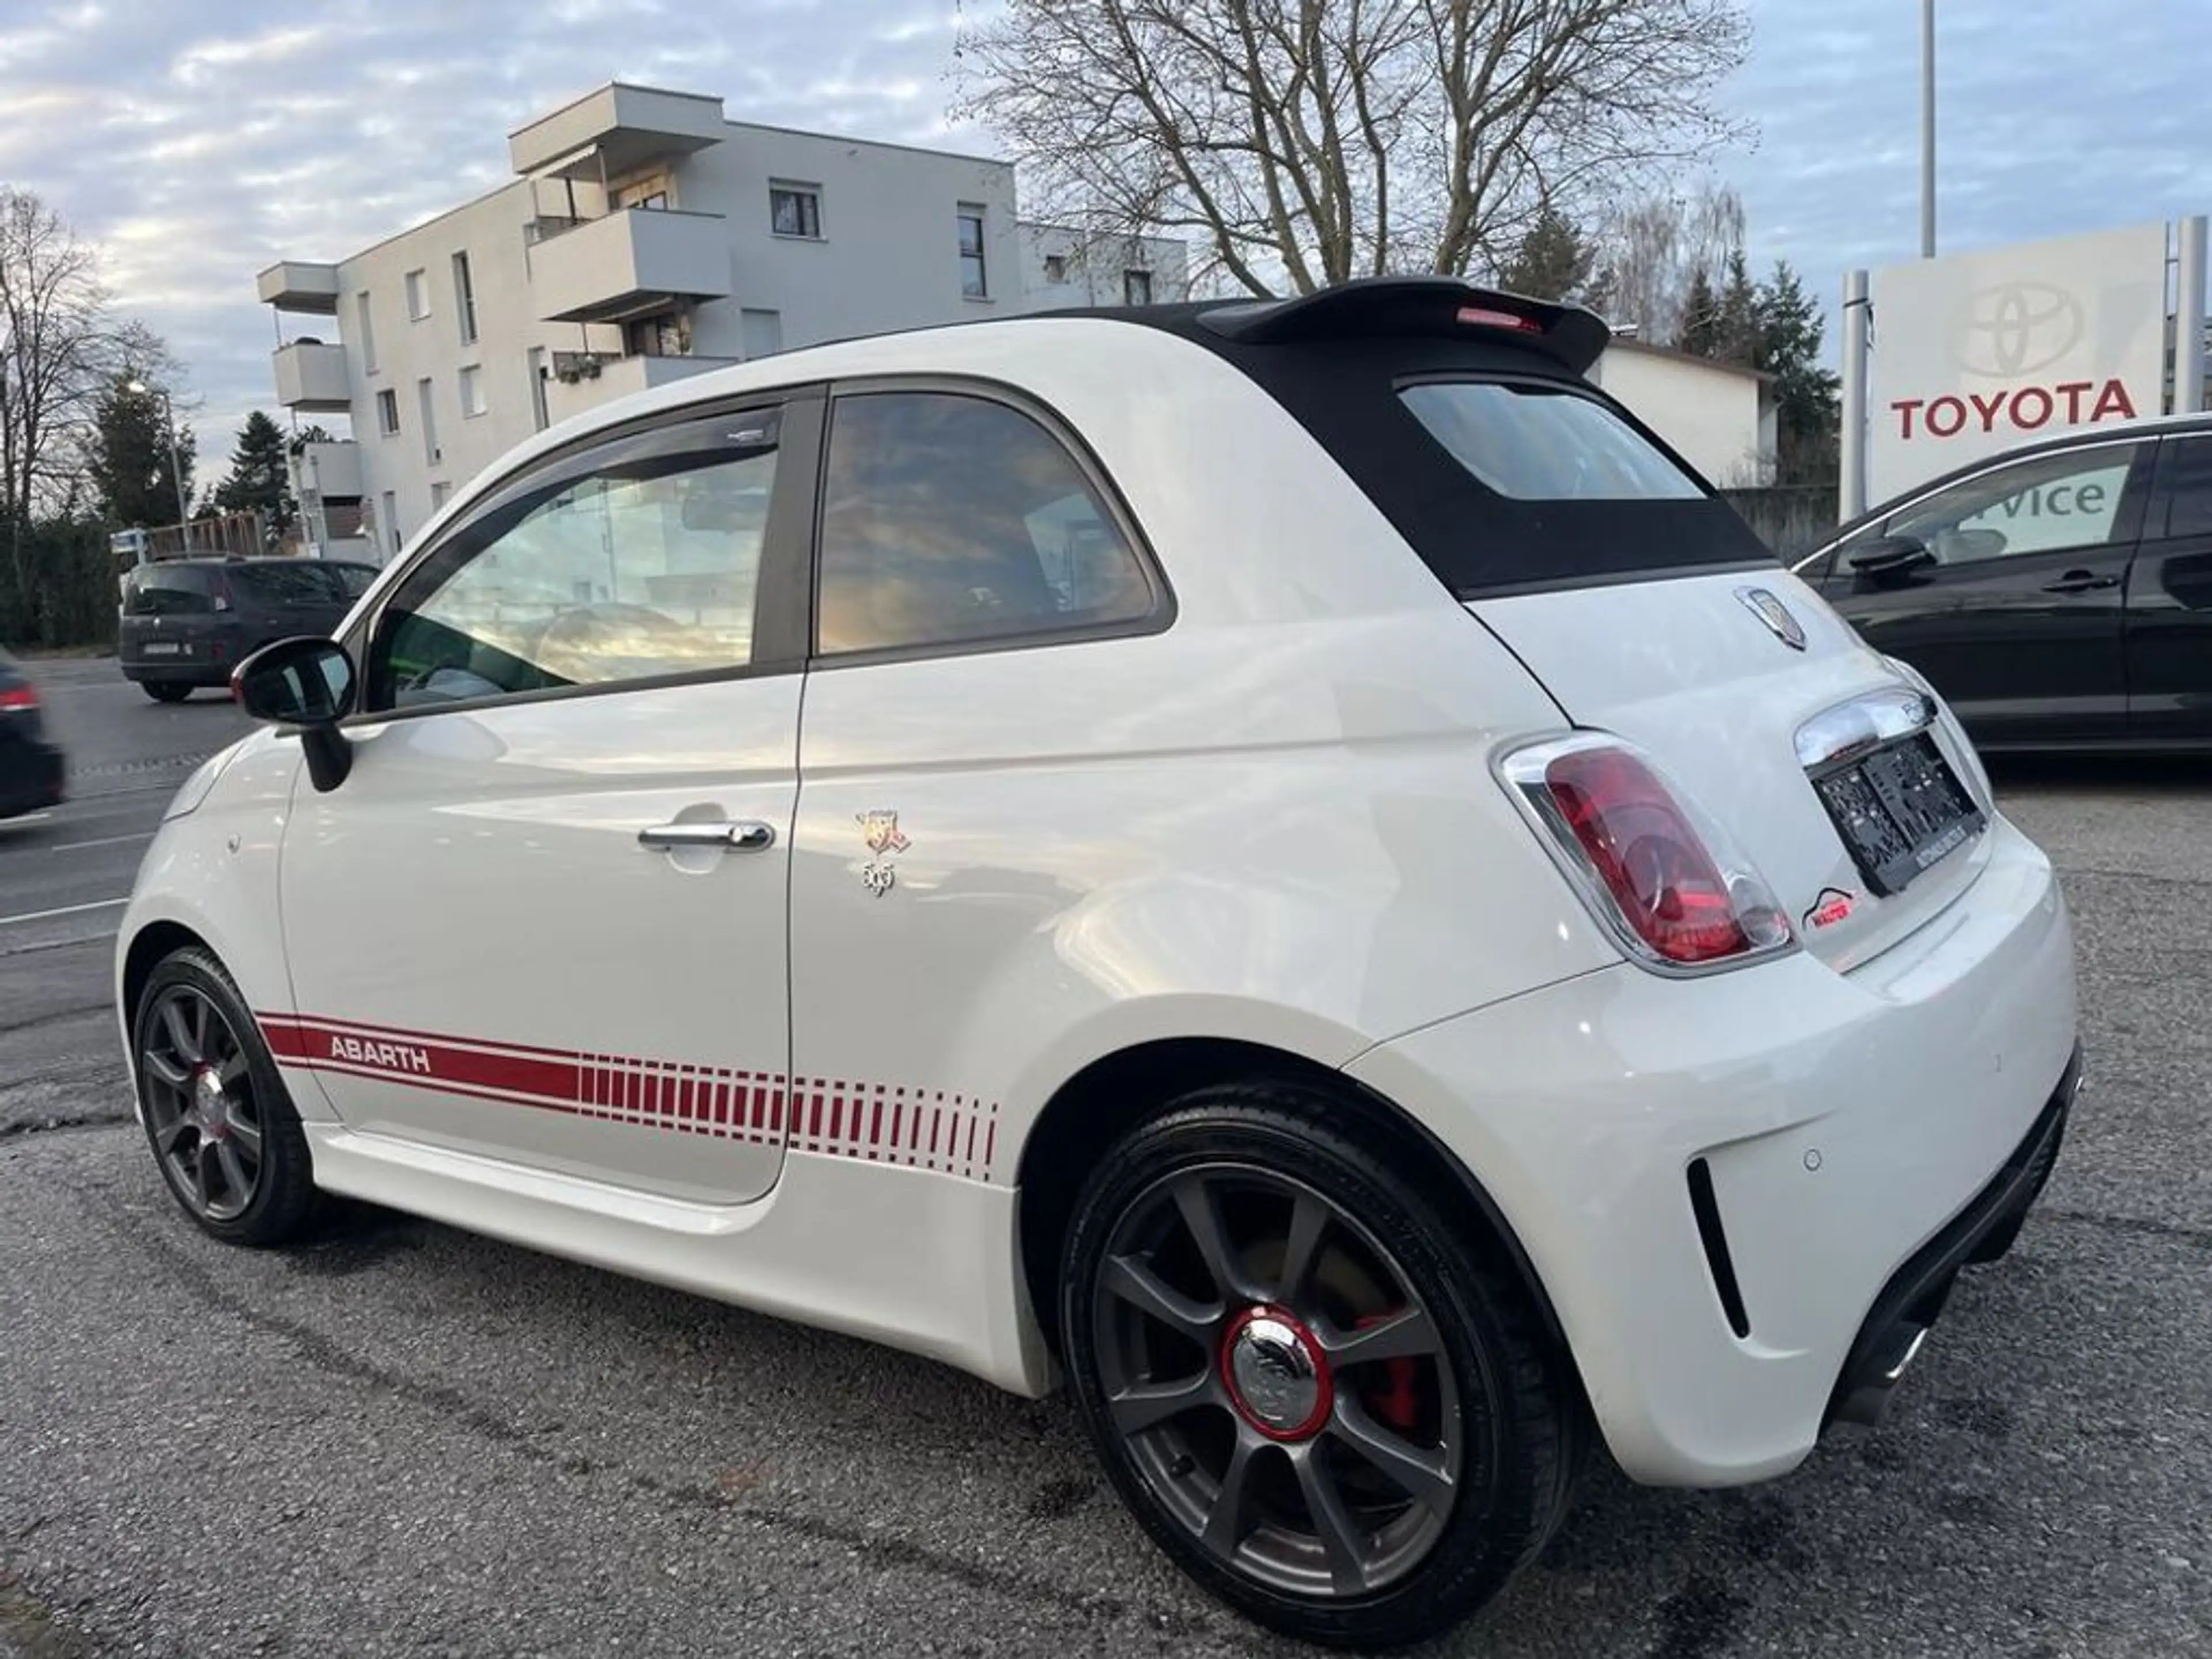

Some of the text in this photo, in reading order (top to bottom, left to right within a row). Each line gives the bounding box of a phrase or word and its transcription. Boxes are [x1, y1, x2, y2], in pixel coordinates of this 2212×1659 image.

[1892, 379, 2137, 440] TOYOTA
[1977, 484, 2105, 519] vice
[331, 1036, 431, 1072] ABARTH
